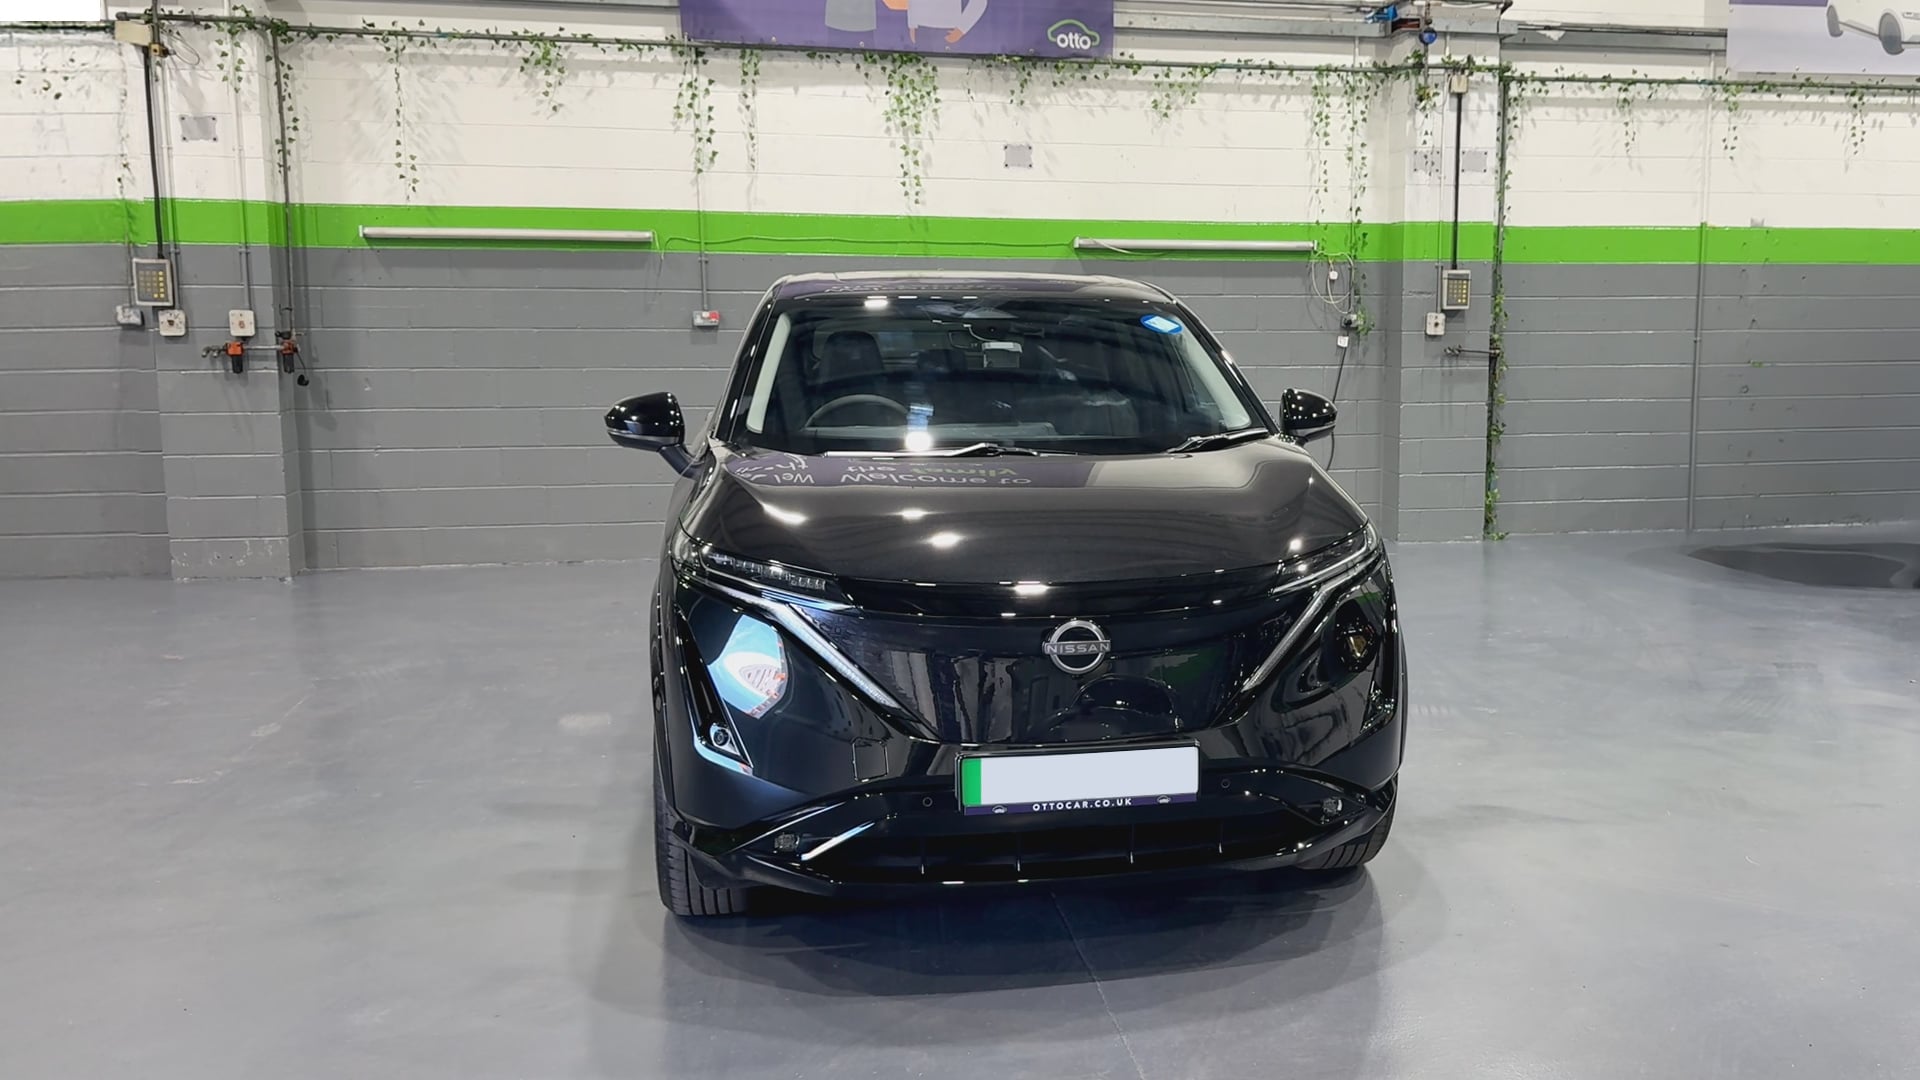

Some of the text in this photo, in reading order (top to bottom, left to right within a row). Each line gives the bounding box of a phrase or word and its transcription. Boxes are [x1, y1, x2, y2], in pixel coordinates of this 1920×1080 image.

[1056, 32, 1091, 50] otto
[1046, 642, 1110, 654] NISSAN
[1032, 798, 1133, 811] OTTOCAR.CO.UK
